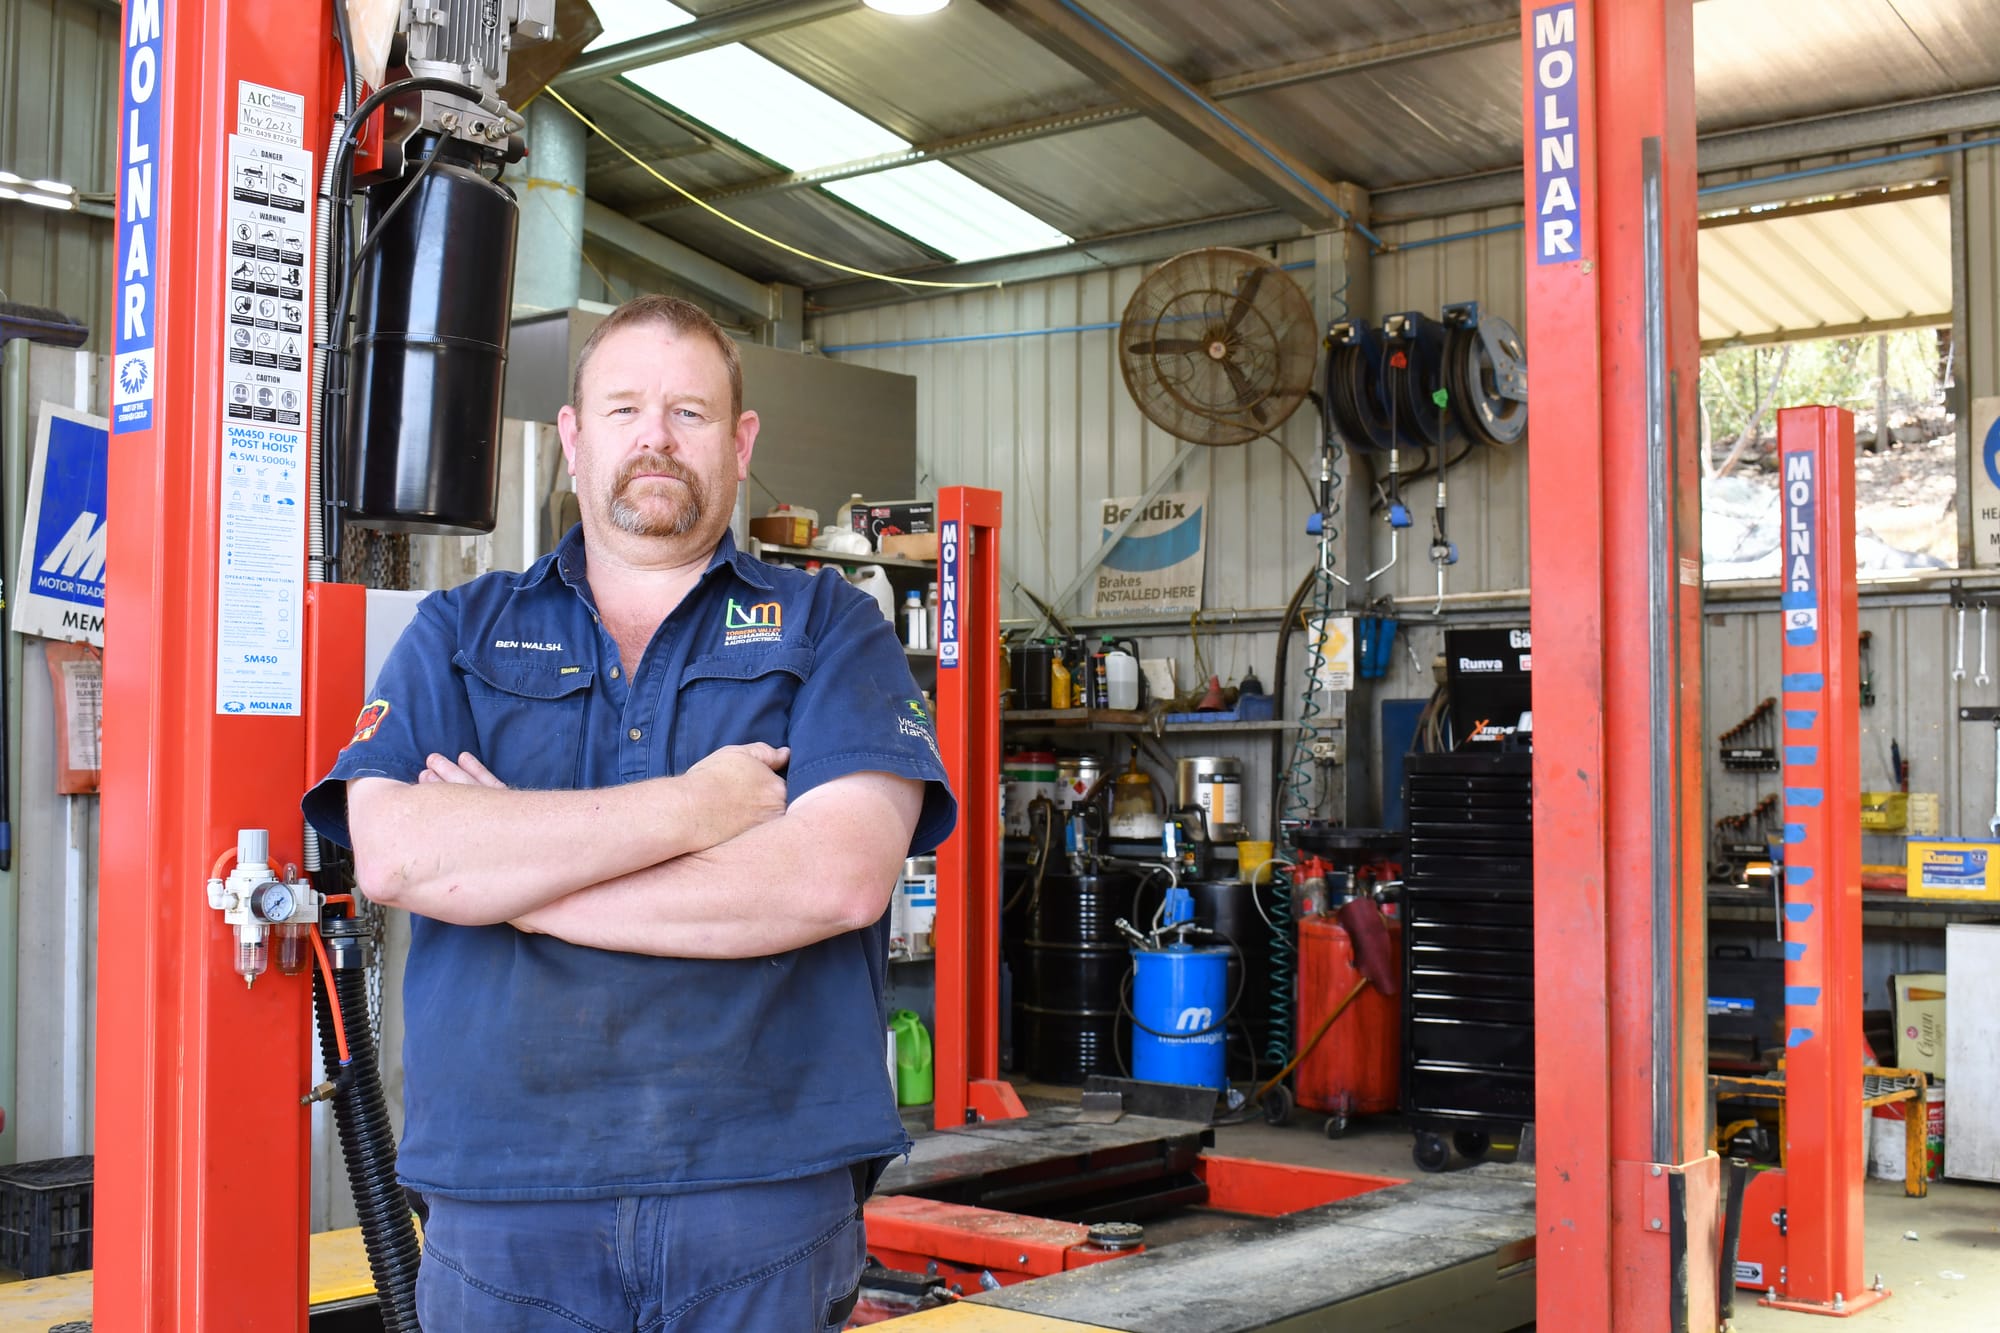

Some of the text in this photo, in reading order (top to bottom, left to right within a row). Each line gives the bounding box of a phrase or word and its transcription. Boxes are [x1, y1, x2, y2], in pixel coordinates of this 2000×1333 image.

[247, 91, 270, 107] AIC
[265, 117, 292, 133] 2023
[1536, 8, 1576, 256] MOLNAR
[261, 150, 283, 161] DANGER
[123, 0, 160, 341] MOLNAR
[260, 212, 286, 224] WARNING
[256, 374, 281, 383] CAUTION
[228, 427, 298, 444] SM450 FOUR
[231, 437, 294, 454] POST HOIST
[240, 453, 296, 469] SWL 5000kg
[38, 576, 74, 593] MOTOR
[942, 524, 957, 639] MOLNAR
[1099, 575, 1142, 589] Brakes
[1097, 585, 1196, 603] INSTALLED HERE
[496, 640, 562, 651] BEN WALSH
[244, 654, 278, 664] SM450
[1460, 657, 1503, 670] Runva
[249, 701, 293, 710] MOLNAR
